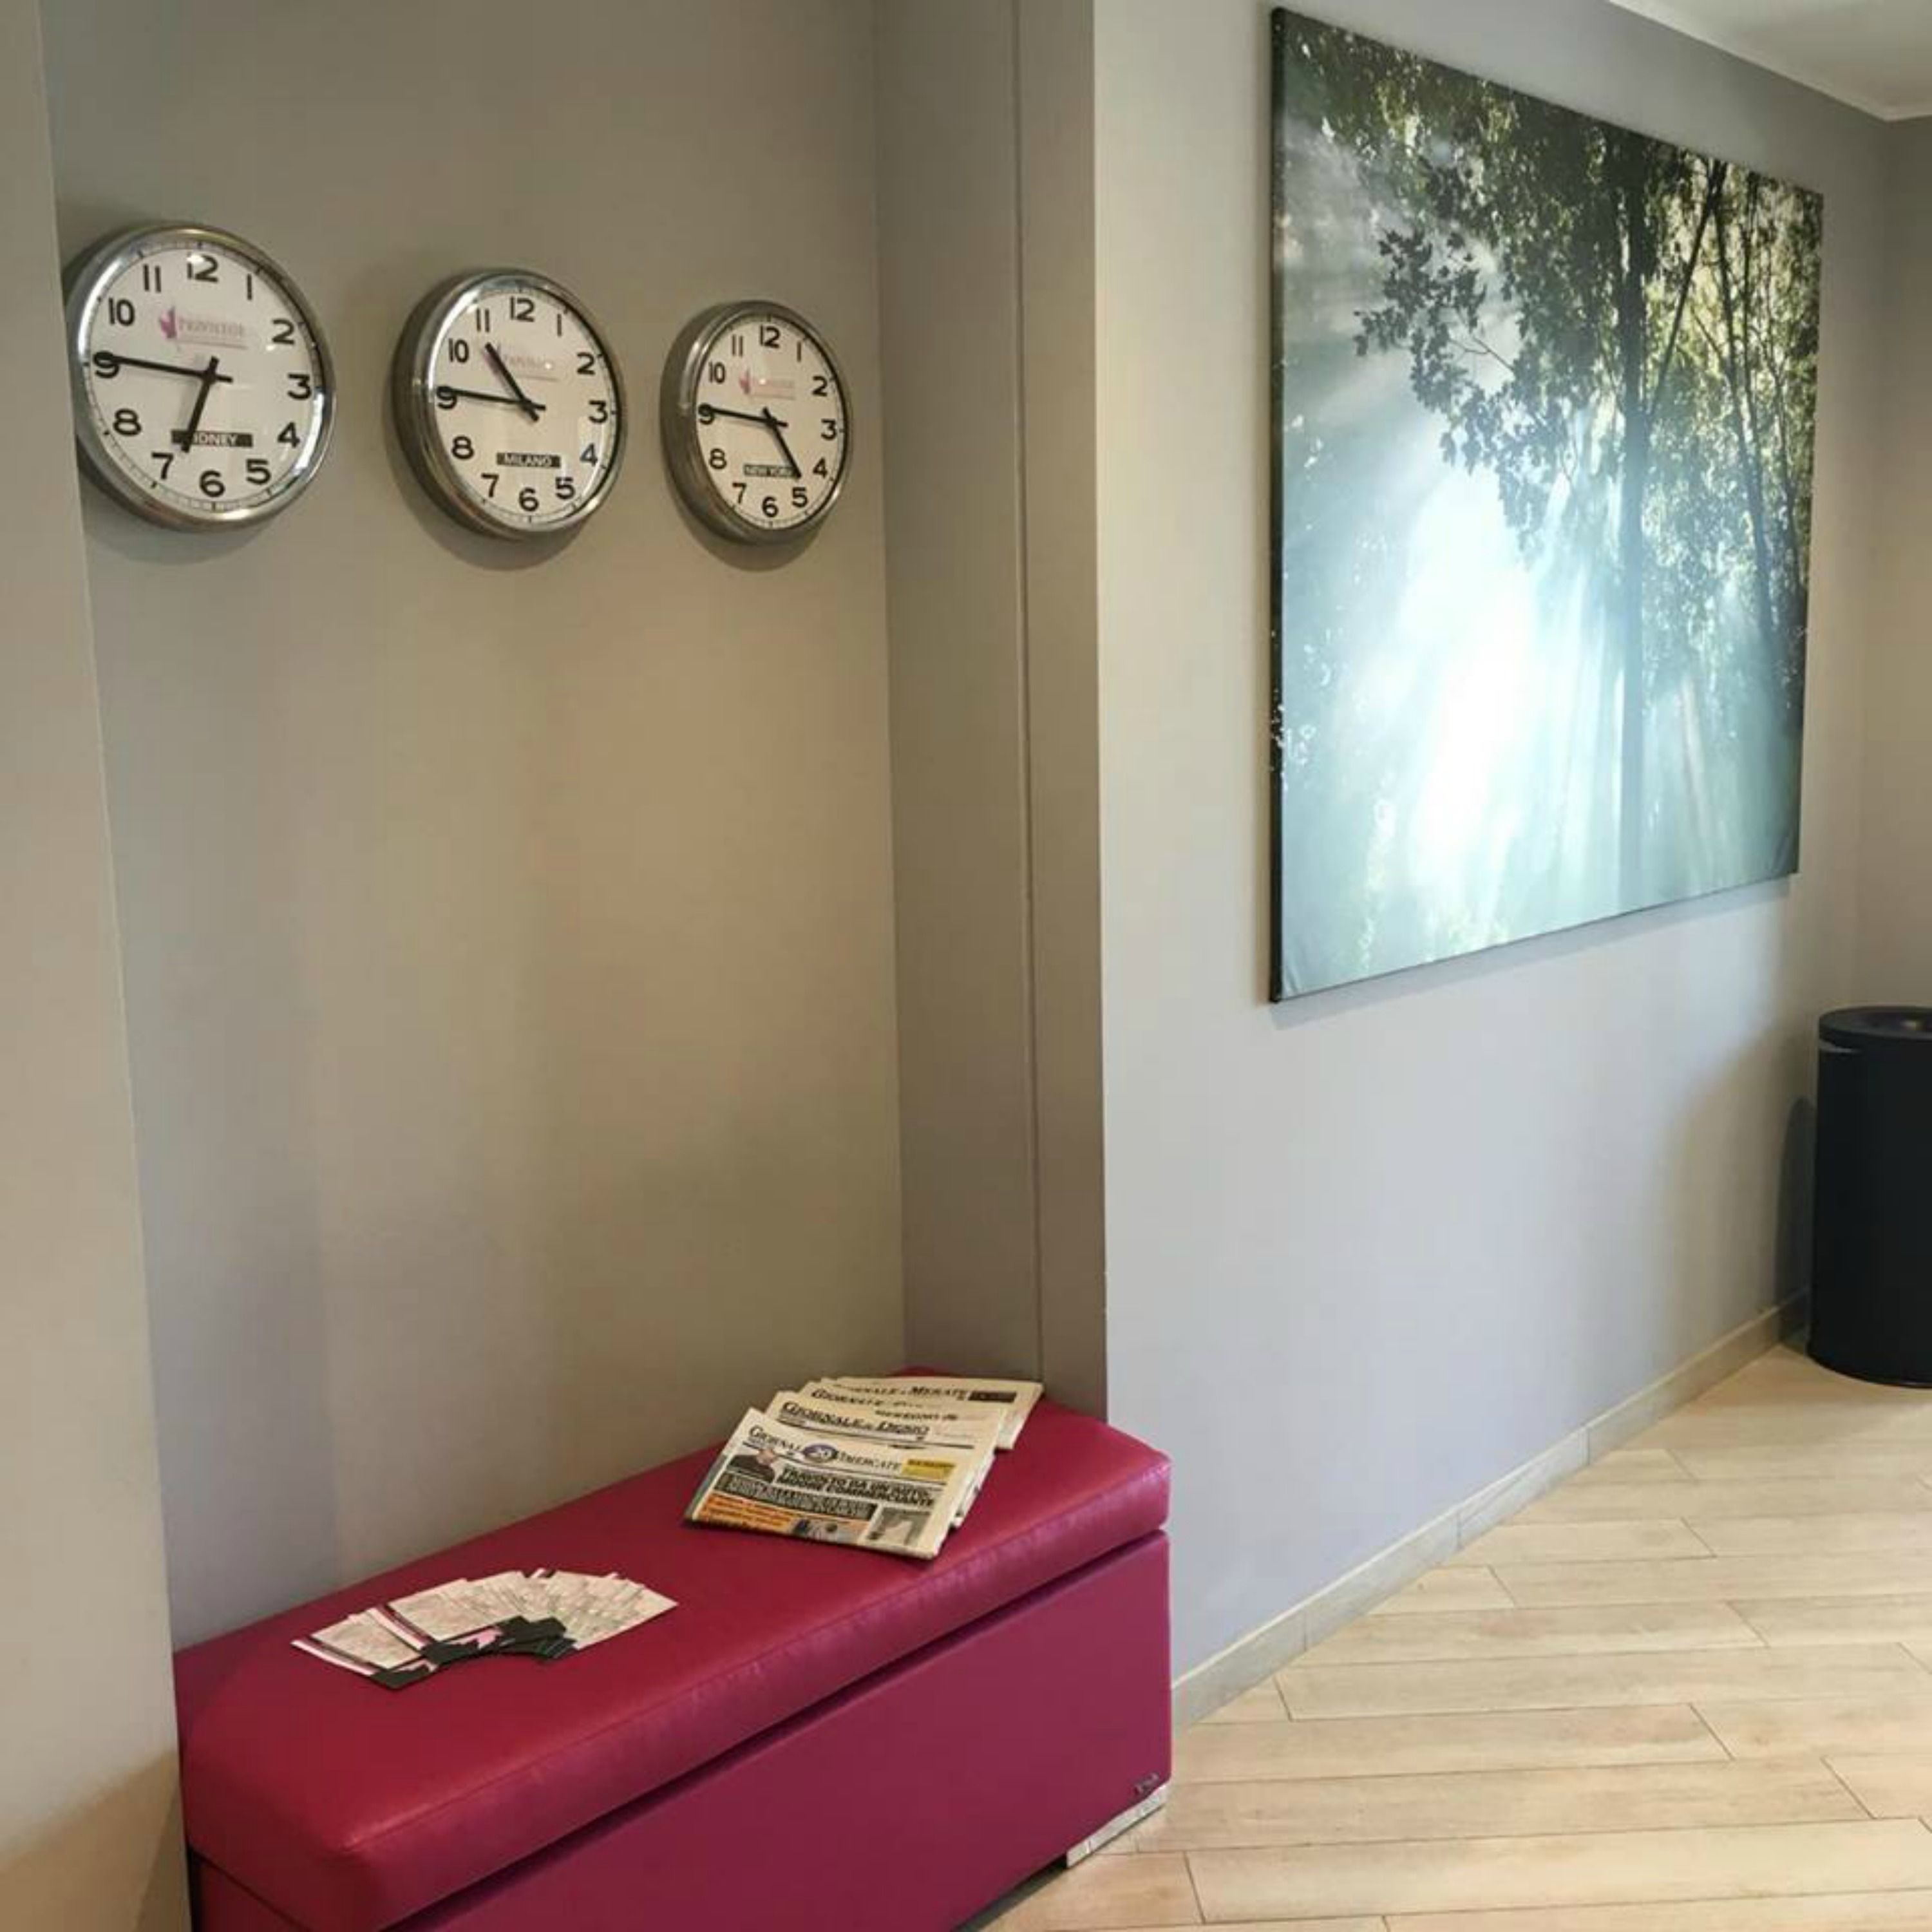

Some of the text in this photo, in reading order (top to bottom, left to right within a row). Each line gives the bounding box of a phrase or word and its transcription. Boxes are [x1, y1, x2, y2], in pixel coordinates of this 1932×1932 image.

[143, 264, 161, 292] 11
[187, 255, 218, 283] 12
[109, 298, 135, 326] 10
[476, 308, 489, 332] 11
[510, 297, 535, 322] 12
[272, 319, 295, 345] 2
[761, 325, 780, 348] 12
[449, 339, 469, 363] 10
[732, 335, 743, 357] 11
[92, 352, 118, 379] 9
[577, 352, 594, 375] 2
[710, 363, 725, 384] 10
[288, 374, 312, 400] 3
[813, 376, 828, 397] 2
[435, 387, 457, 410] 9
[113, 409, 141, 436] 8
[589, 401, 608, 424] 3
[698, 404, 715, 425] 9
[278, 422, 300, 448] 4
[821, 419, 837, 440] 3
[451, 436, 474, 460] 8
[580, 444, 598, 466] 4
[709, 448, 726, 469] 8
[152, 452, 173, 480] 7
[504, 452, 552, 468] MILANO
[813, 458, 828, 478] 4
[247, 459, 271, 485] 5
[200, 471, 225, 497] 6
[481, 473, 498, 497] 7
[556, 477, 575, 499] 5
[732, 482, 746, 504] 7
[519, 488, 538, 511] 6
[762, 497, 779, 518] 6
[792, 487, 808, 508] 5
